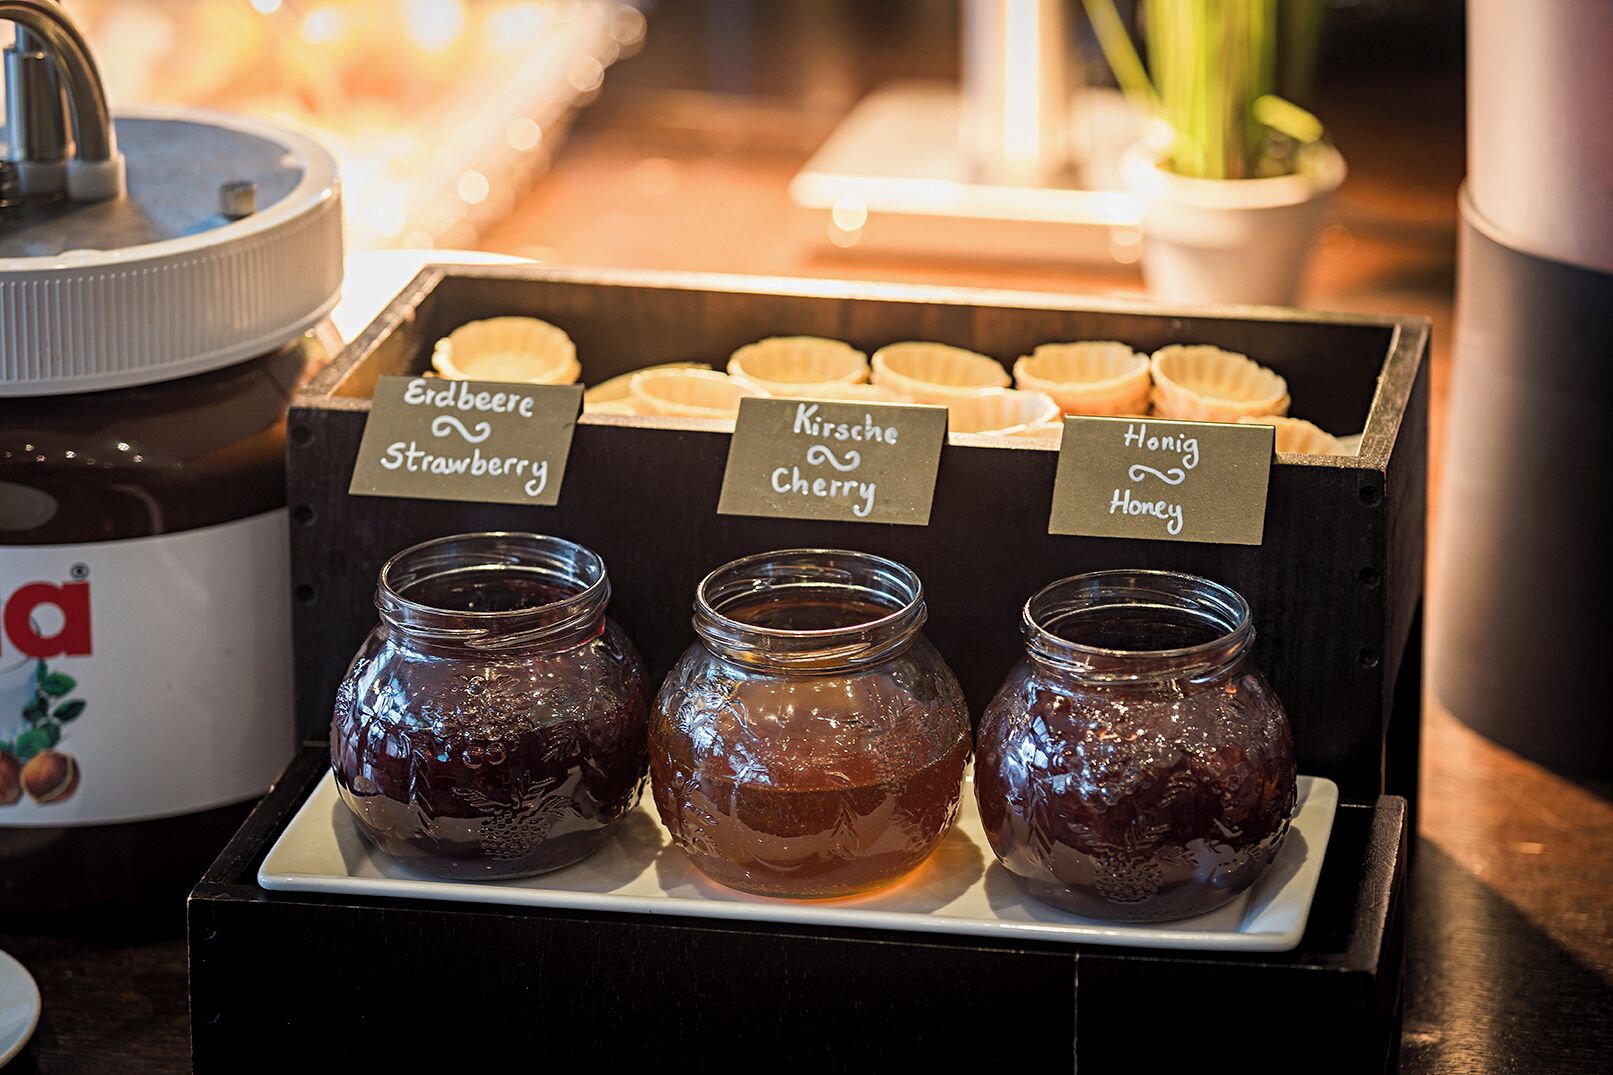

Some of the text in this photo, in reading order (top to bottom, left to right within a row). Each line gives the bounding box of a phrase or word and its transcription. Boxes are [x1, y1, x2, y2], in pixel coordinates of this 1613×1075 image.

[403, 378, 534, 417] Erdbeere
[793, 403, 899, 445] Kirsche
[1123, 423, 1199, 469] Honig
[380, 440, 548, 496] Strawberry
[771, 465, 876, 517] Cherry
[1109, 488, 1184, 535] Honey
[0, 581, 92, 660] a
